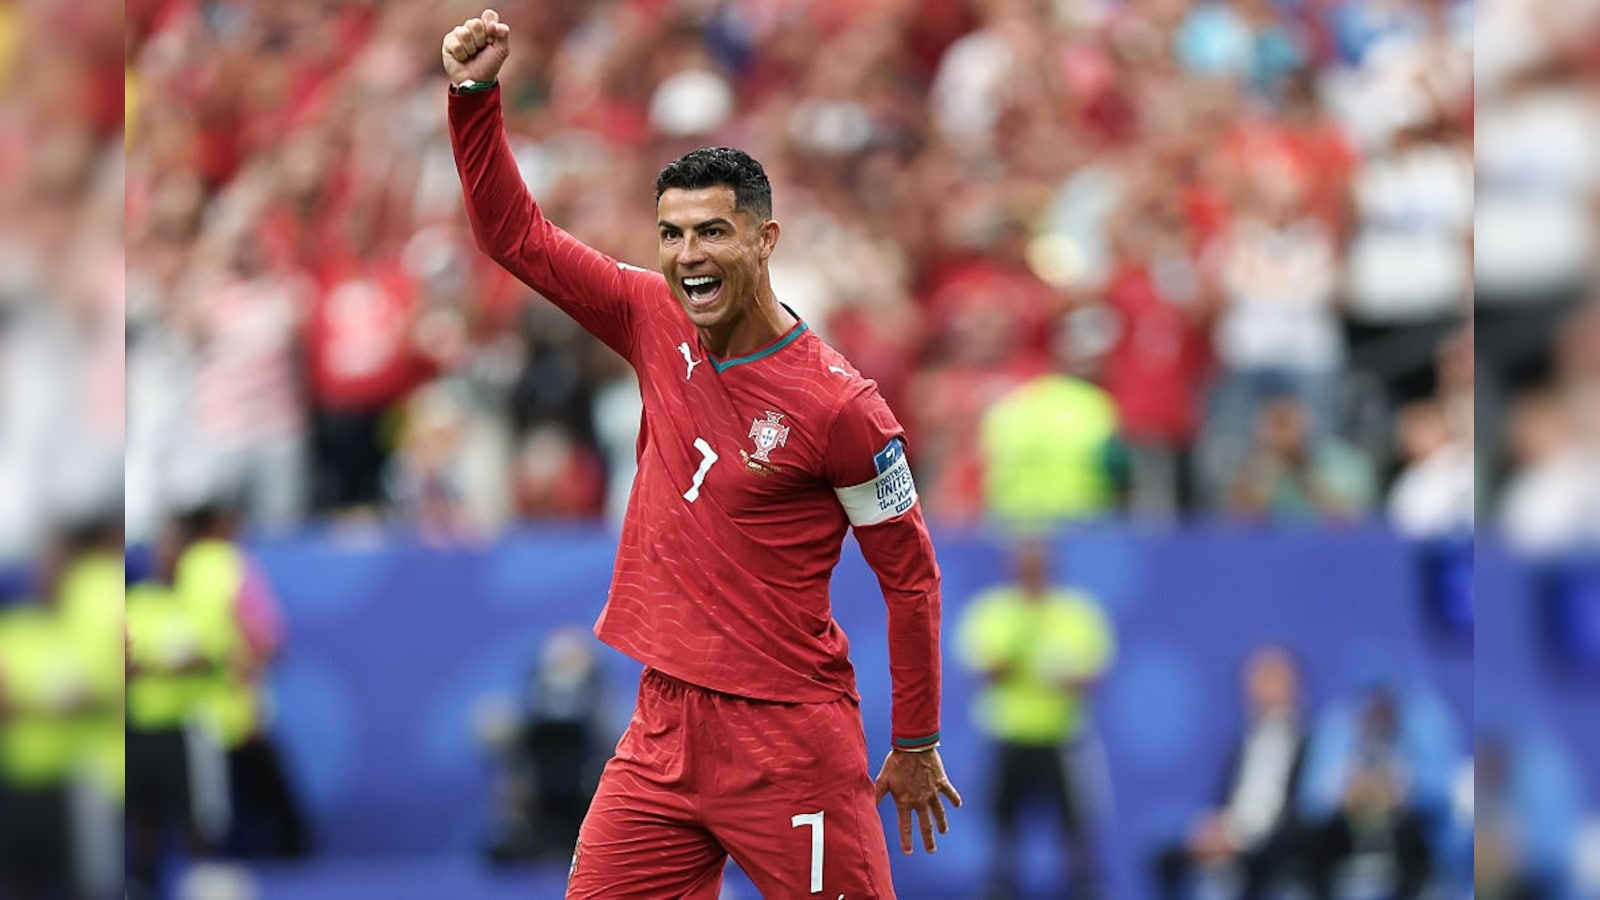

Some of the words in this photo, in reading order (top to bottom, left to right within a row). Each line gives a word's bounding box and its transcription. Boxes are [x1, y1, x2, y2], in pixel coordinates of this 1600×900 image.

[683, 437, 719, 503] 7
[878, 499, 896, 510] the
[791, 810, 825, 893] 7
